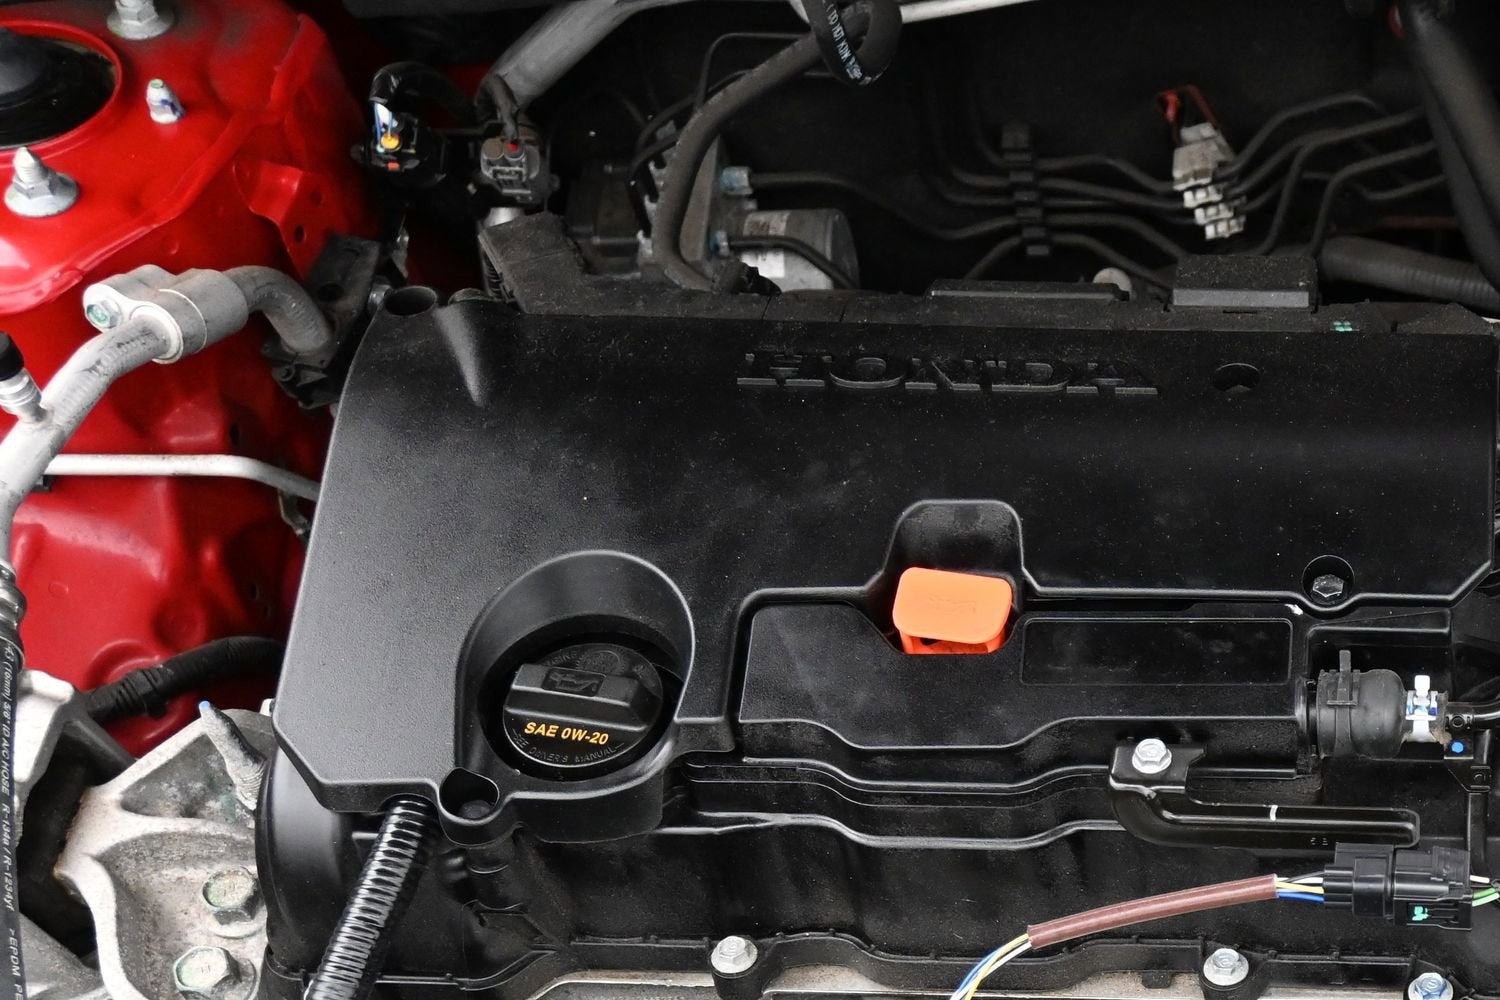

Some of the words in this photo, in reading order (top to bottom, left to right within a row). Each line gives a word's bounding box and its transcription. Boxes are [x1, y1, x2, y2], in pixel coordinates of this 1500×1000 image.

[737, 353, 1158, 395] HONDA
[524, 721, 560, 739] SAE
[560, 727, 610, 745] 0W-20
[0, 760, 10, 796] HOSE
